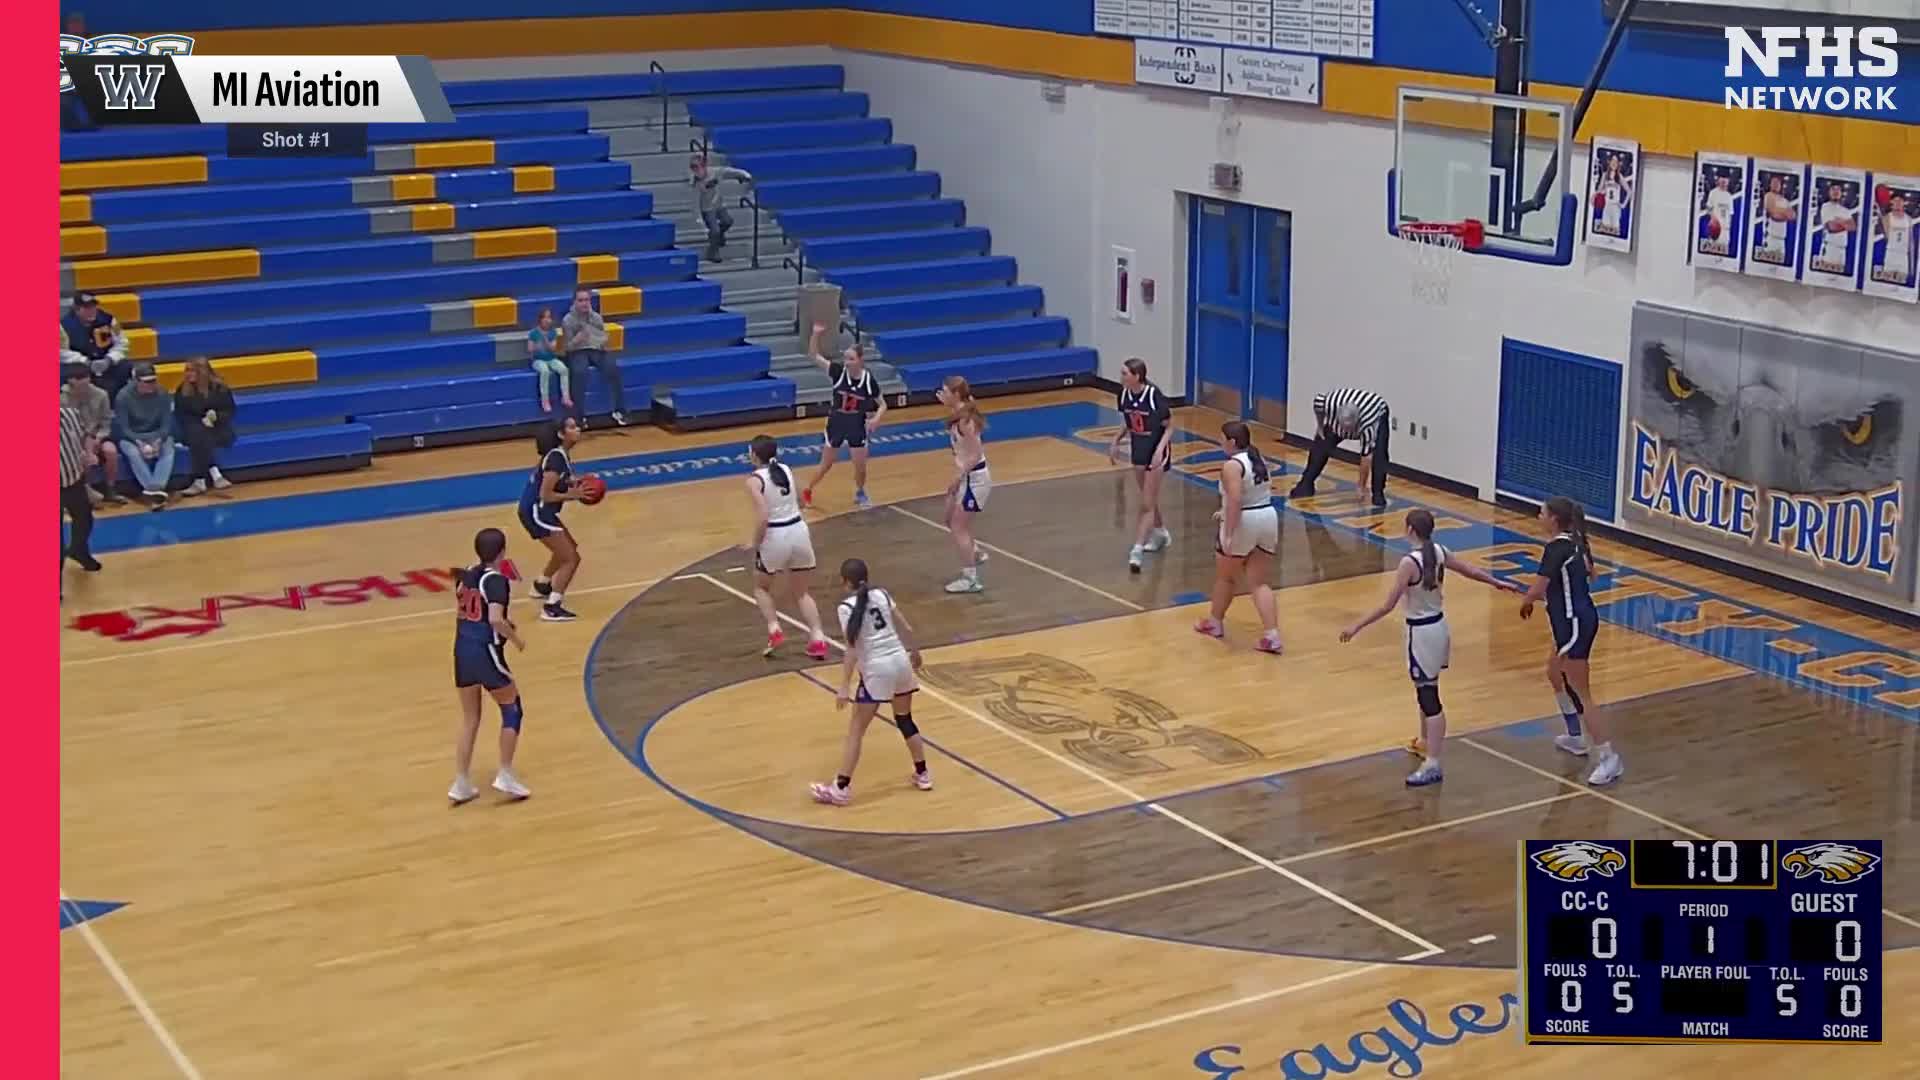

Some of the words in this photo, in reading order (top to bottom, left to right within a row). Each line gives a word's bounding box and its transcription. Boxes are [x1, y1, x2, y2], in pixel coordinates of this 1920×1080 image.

[1194, 60, 1217, 75] Bank
[1630, 422, 1757, 542] EAGLE
[1767, 481, 1902, 580] PRIDE
[869, 607, 887, 630] 3
